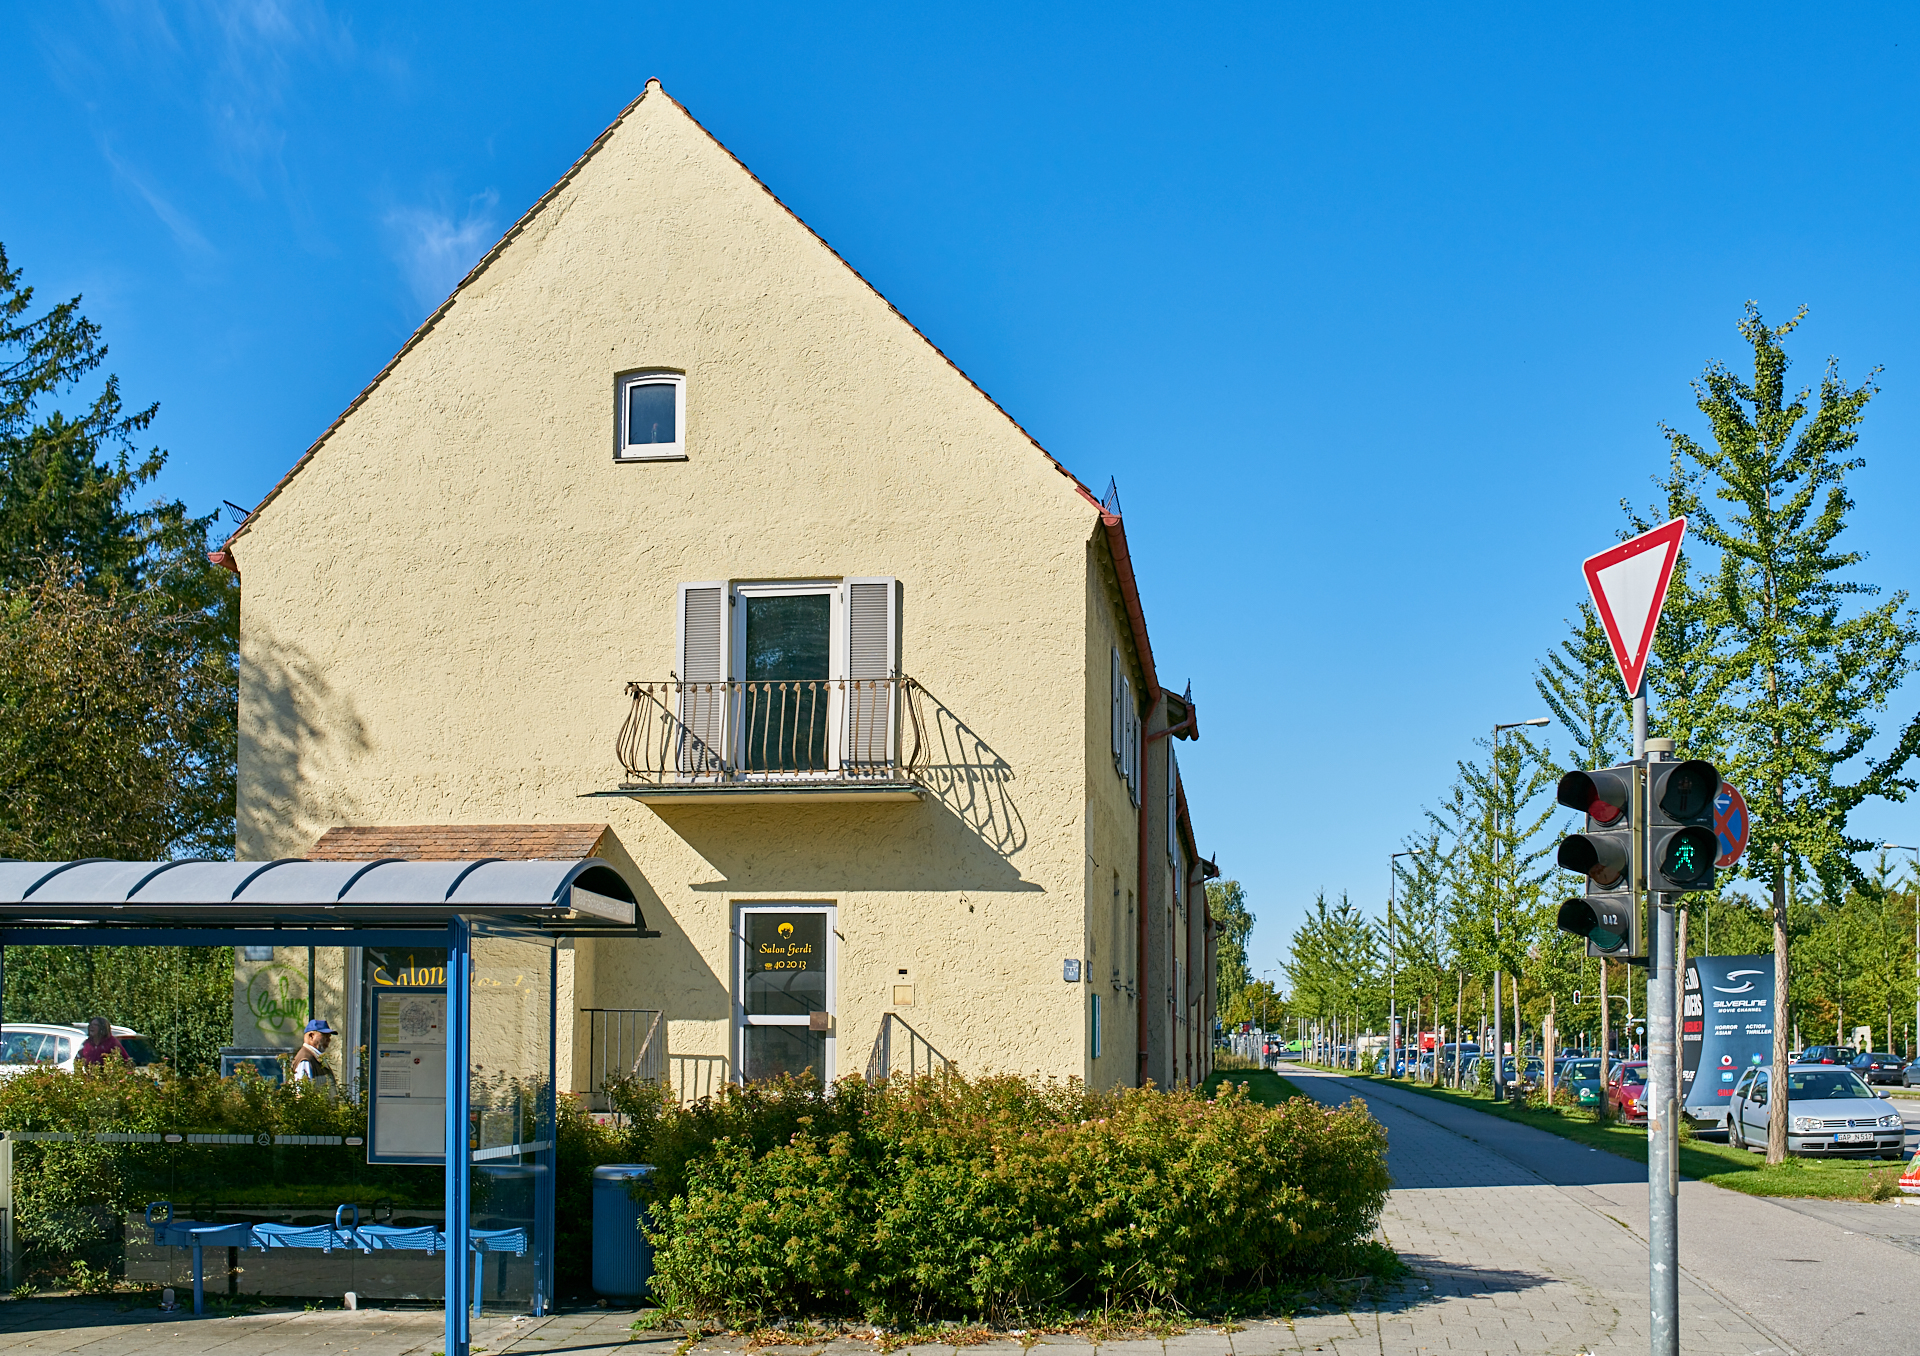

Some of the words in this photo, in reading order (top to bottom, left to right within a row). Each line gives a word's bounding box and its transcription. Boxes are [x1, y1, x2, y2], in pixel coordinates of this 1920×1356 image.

[759, 943, 785, 953] Salon
[787, 943, 812, 956] Gerdi
[373, 954, 446, 986] Salon
[774, 961, 785, 970] 40
[799, 961, 807, 970] 13
[1713, 999, 1767, 1008] SILVERLINE
